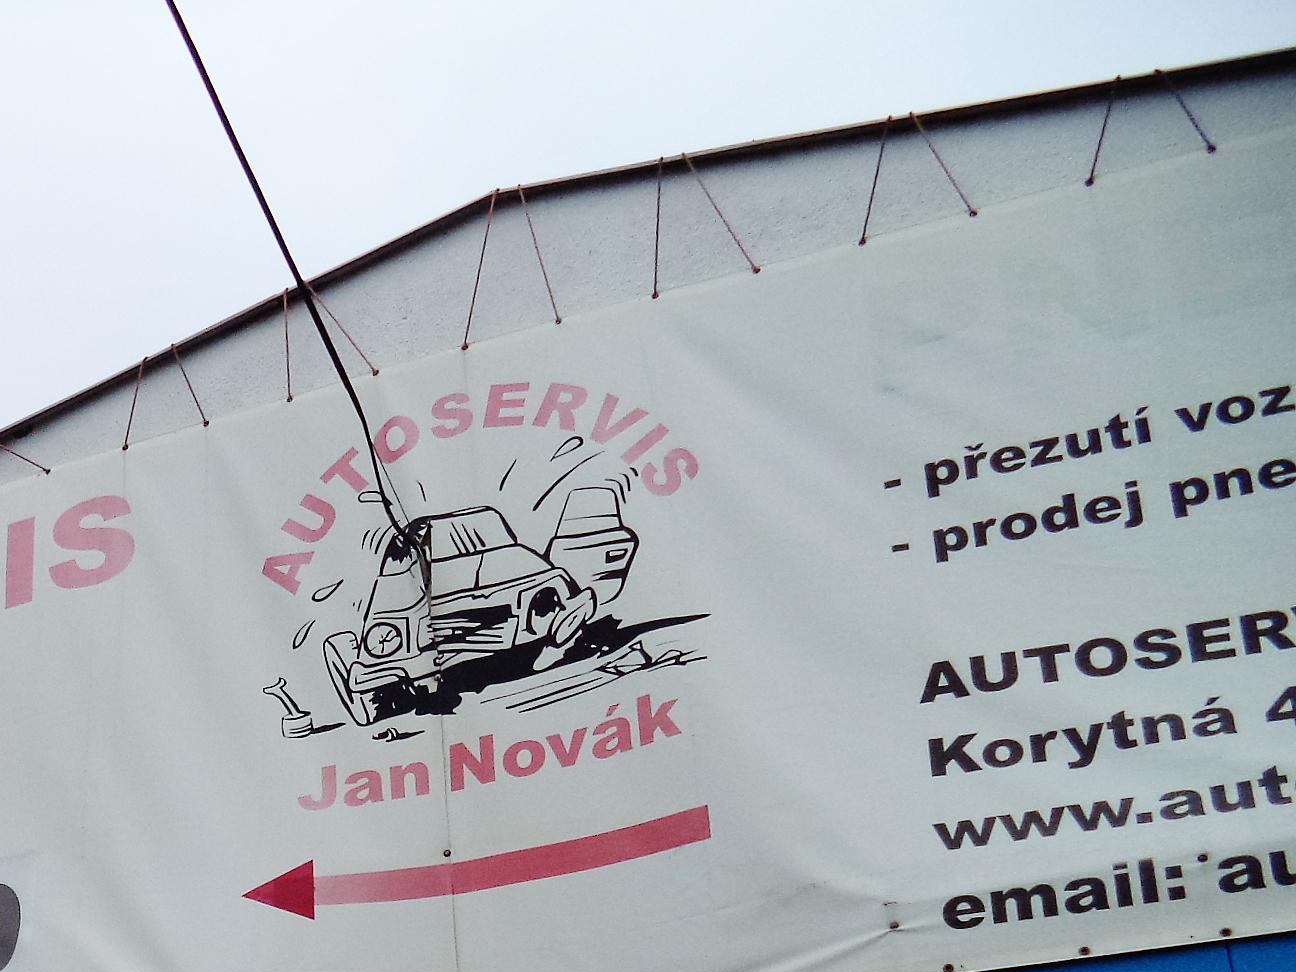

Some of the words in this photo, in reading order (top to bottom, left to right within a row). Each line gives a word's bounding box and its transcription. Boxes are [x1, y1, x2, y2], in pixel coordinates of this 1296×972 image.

[263, 382, 700, 596] AUTOSERVIS
[924, 405, 1151, 498] přezutí
[1173, 385, 1296, 433] voz
[933, 480, 1144, 563] prodej
[1168, 459, 1296, 519] pne
[920, 606, 1296, 704] AUTOSER
[297, 760, 430, 811] Jan
[449, 693, 682, 792] Novák
[927, 696, 1238, 777] Korytná
[933, 765, 1296, 850] www.aut
[941, 858, 1188, 930] email:
